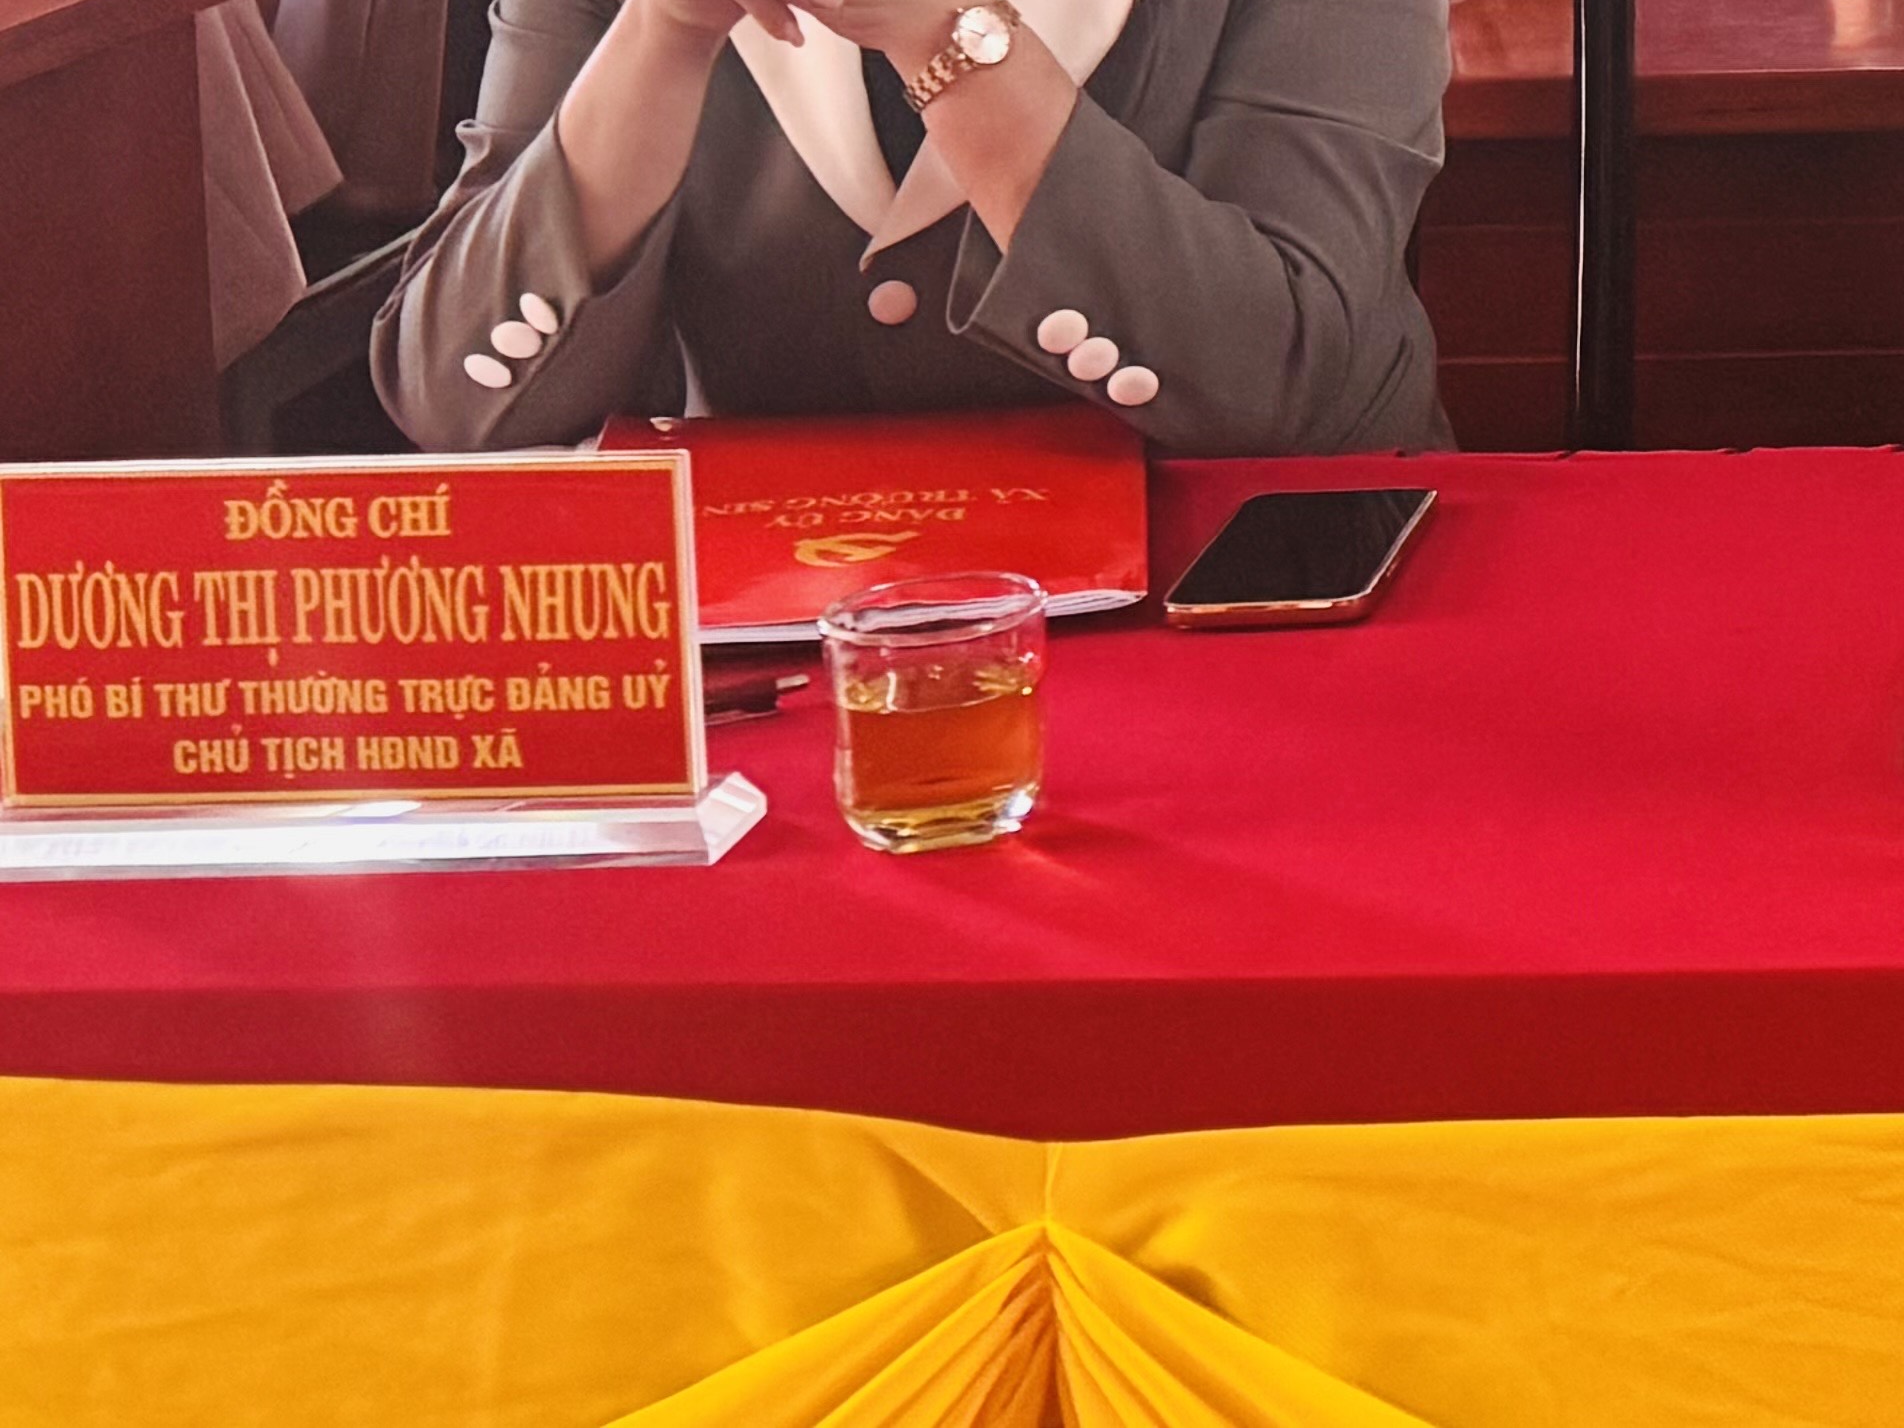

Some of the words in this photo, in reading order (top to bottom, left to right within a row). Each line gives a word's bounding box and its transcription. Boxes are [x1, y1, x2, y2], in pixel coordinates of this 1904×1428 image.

[224, 479, 358, 539] ĐỒNG
[368, 483, 451, 538] CHÍ
[16, 561, 184, 649] DƯƠNG
[194, 568, 281, 666] THỊ
[291, 555, 489, 643] PHƯƠNG
[499, 562, 670, 641] NHUNG
[19, 678, 93, 718] PHÓ
[105, 677, 142, 718] BÍ
[154, 679, 231, 717] THƯ
[238, 671, 388, 714] THƯỜNG
[398, 675, 494, 719] TRỰC
[506, 663, 610, 711] ĐẢNG
[174, 725, 249, 773] CHỦ
[261, 737, 345, 778] TỊCH
[357, 736, 459, 770] HĐND
[472, 728, 522, 768] XÃ
